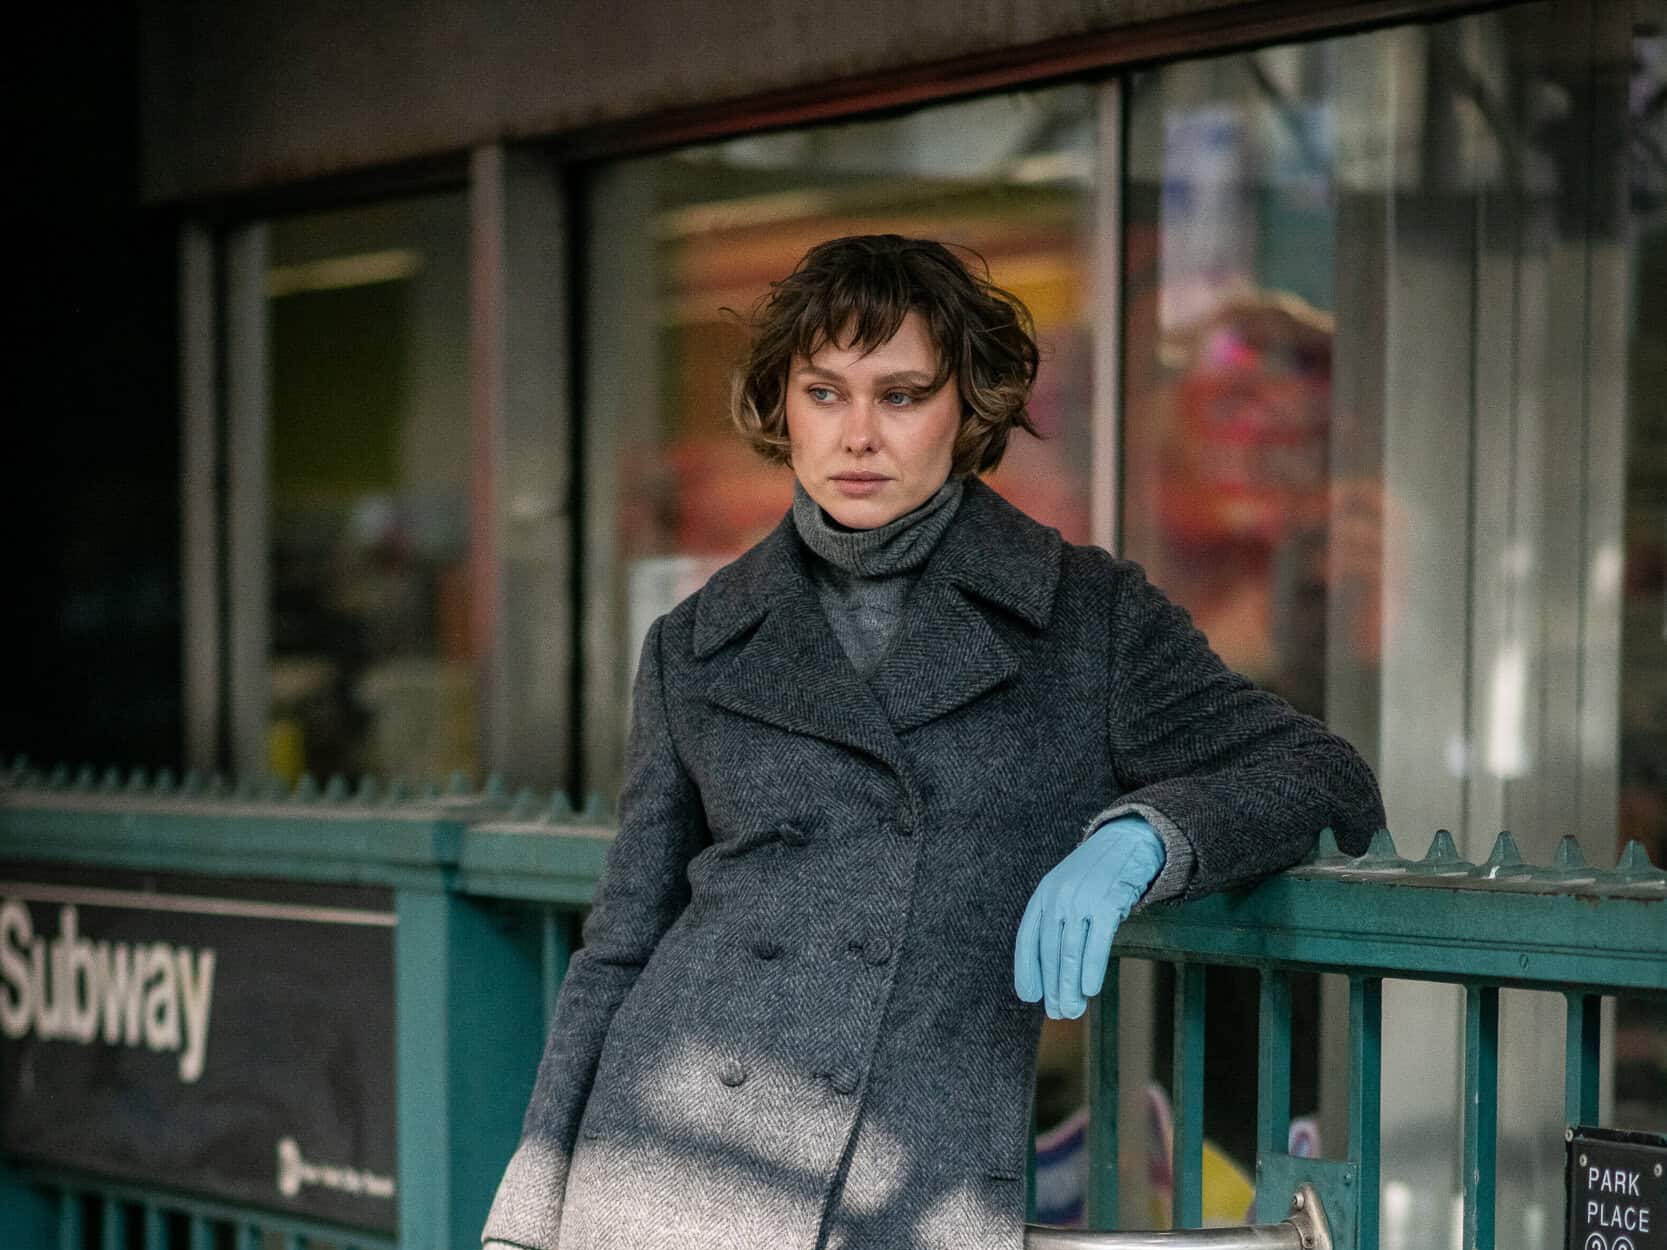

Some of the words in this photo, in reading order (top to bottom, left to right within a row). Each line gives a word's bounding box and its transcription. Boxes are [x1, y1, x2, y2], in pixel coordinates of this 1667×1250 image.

[0, 898, 217, 1083] Subway
[1588, 1167, 1640, 1197] PARK
[1587, 1201, 1649, 1233] PLACE
